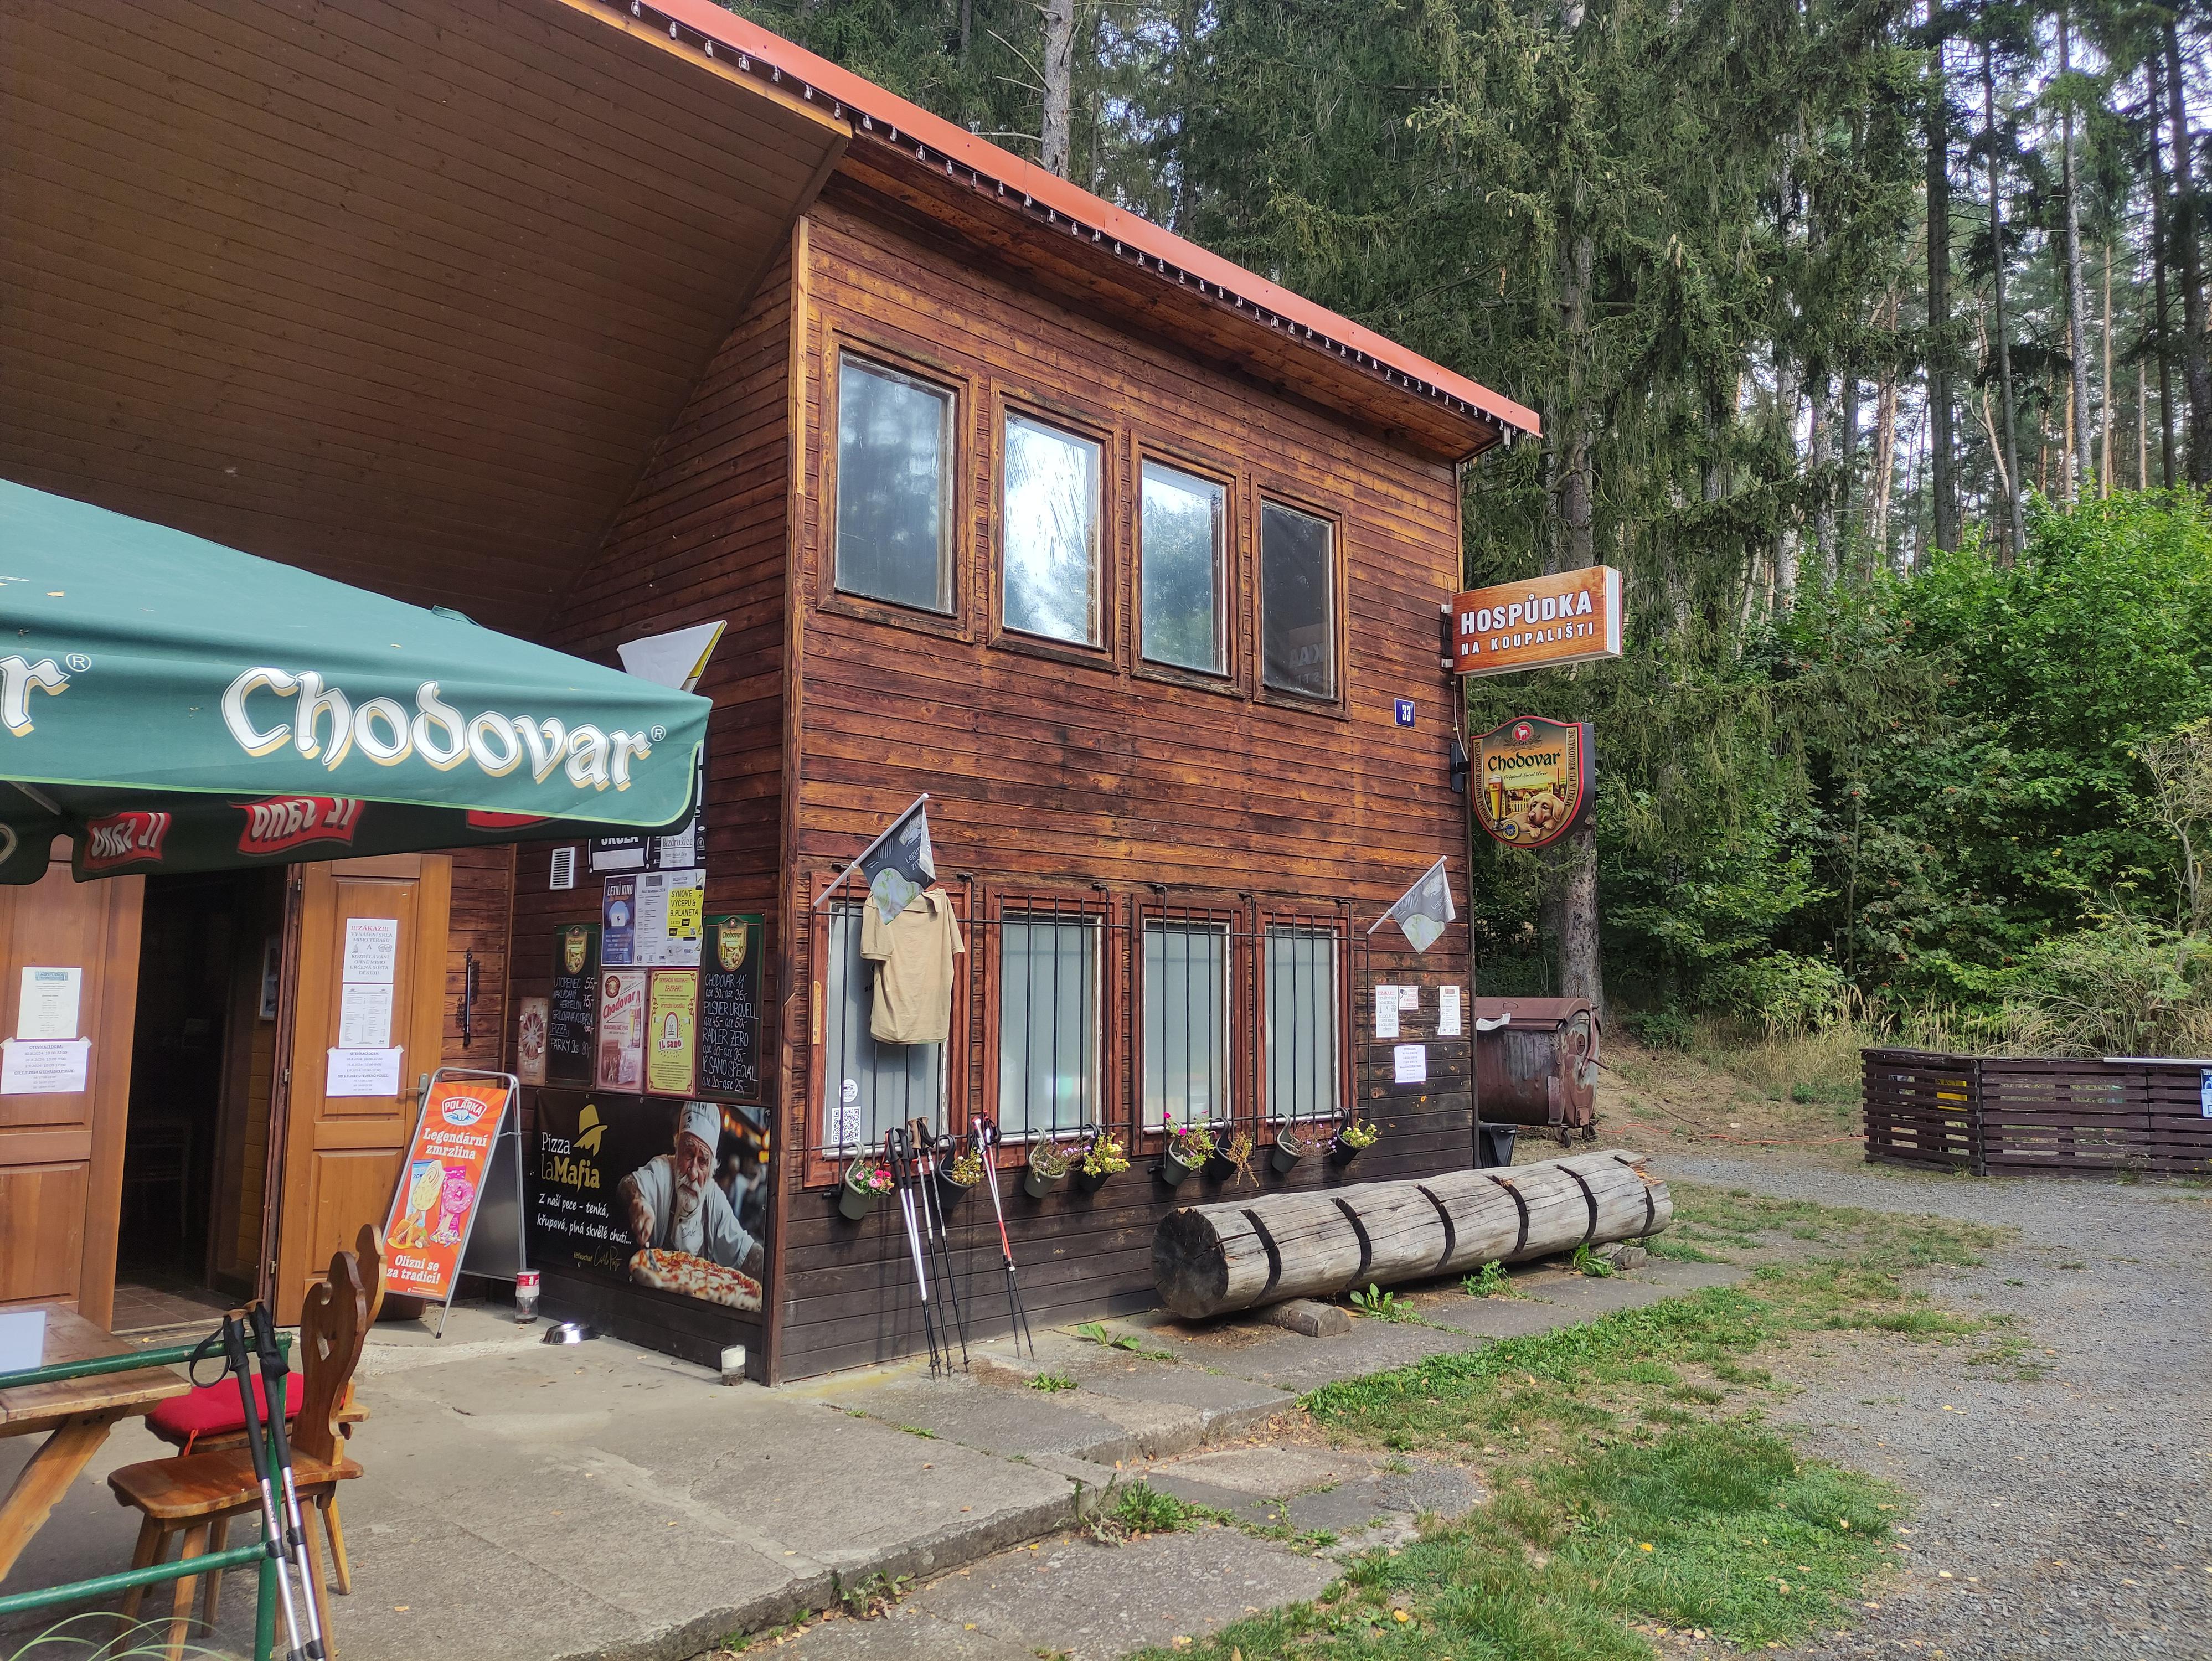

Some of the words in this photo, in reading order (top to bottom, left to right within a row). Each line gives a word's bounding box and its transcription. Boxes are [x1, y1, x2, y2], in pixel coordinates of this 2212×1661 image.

[1461, 590, 1592, 635] HOSPŮDKA
[1461, 641, 1480, 656] NA
[1491, 622, 1593, 651] KOUPALIŠTI
[1401, 704, 1411, 721] 33
[221, 667, 652, 792] Chodovar
[1567, 730, 1576, 770] REGIONÁLNĚ
[1488, 752, 1561, 772] Chodovar
[1565, 790, 1576, 808] MYSLI
[1477, 801, 1492, 824] PIVOVAR
[663, 837, 693, 847] Bezdružice
[607, 883, 621, 896] LETNÍ
[621, 884, 633, 895] KINO
[671, 898, 692, 907] VÝČEPU
[554, 977, 581, 988] UTOPENEC
[705, 973, 735, 988] CHODOVAR
[603, 990, 636, 1019] Chodovar
[704, 1001, 729, 1015] PILSNER
[729, 1002, 759, 1019] URQUELL
[551, 1023, 568, 1035] PIZZA
[703, 1027, 729, 1045] RADLER
[730, 1030, 749, 1046] ZERO
[709, 1056, 727, 1076] SANO
[423, 1128, 489, 1147] Legendární
[541, 1132, 570, 1154] Pizza
[425, 1145, 476, 1160] zmrzlina
[541, 1153, 600, 1193] laMafia
[538, 1193, 545, 1204] Z
[547, 1193, 561, 1208] naší
[561, 1201, 577, 1212] pece
[586, 1201, 609, 1218] tenká,
[537, 1213, 568, 1232] křupavá,
[569, 1221, 584, 1236] plná
[586, 1224, 608, 1240] skvělé
[395, 1254, 426, 1269] Olízni
[427, 1261, 439, 1271] se
[386, 1268, 399, 1278] za
